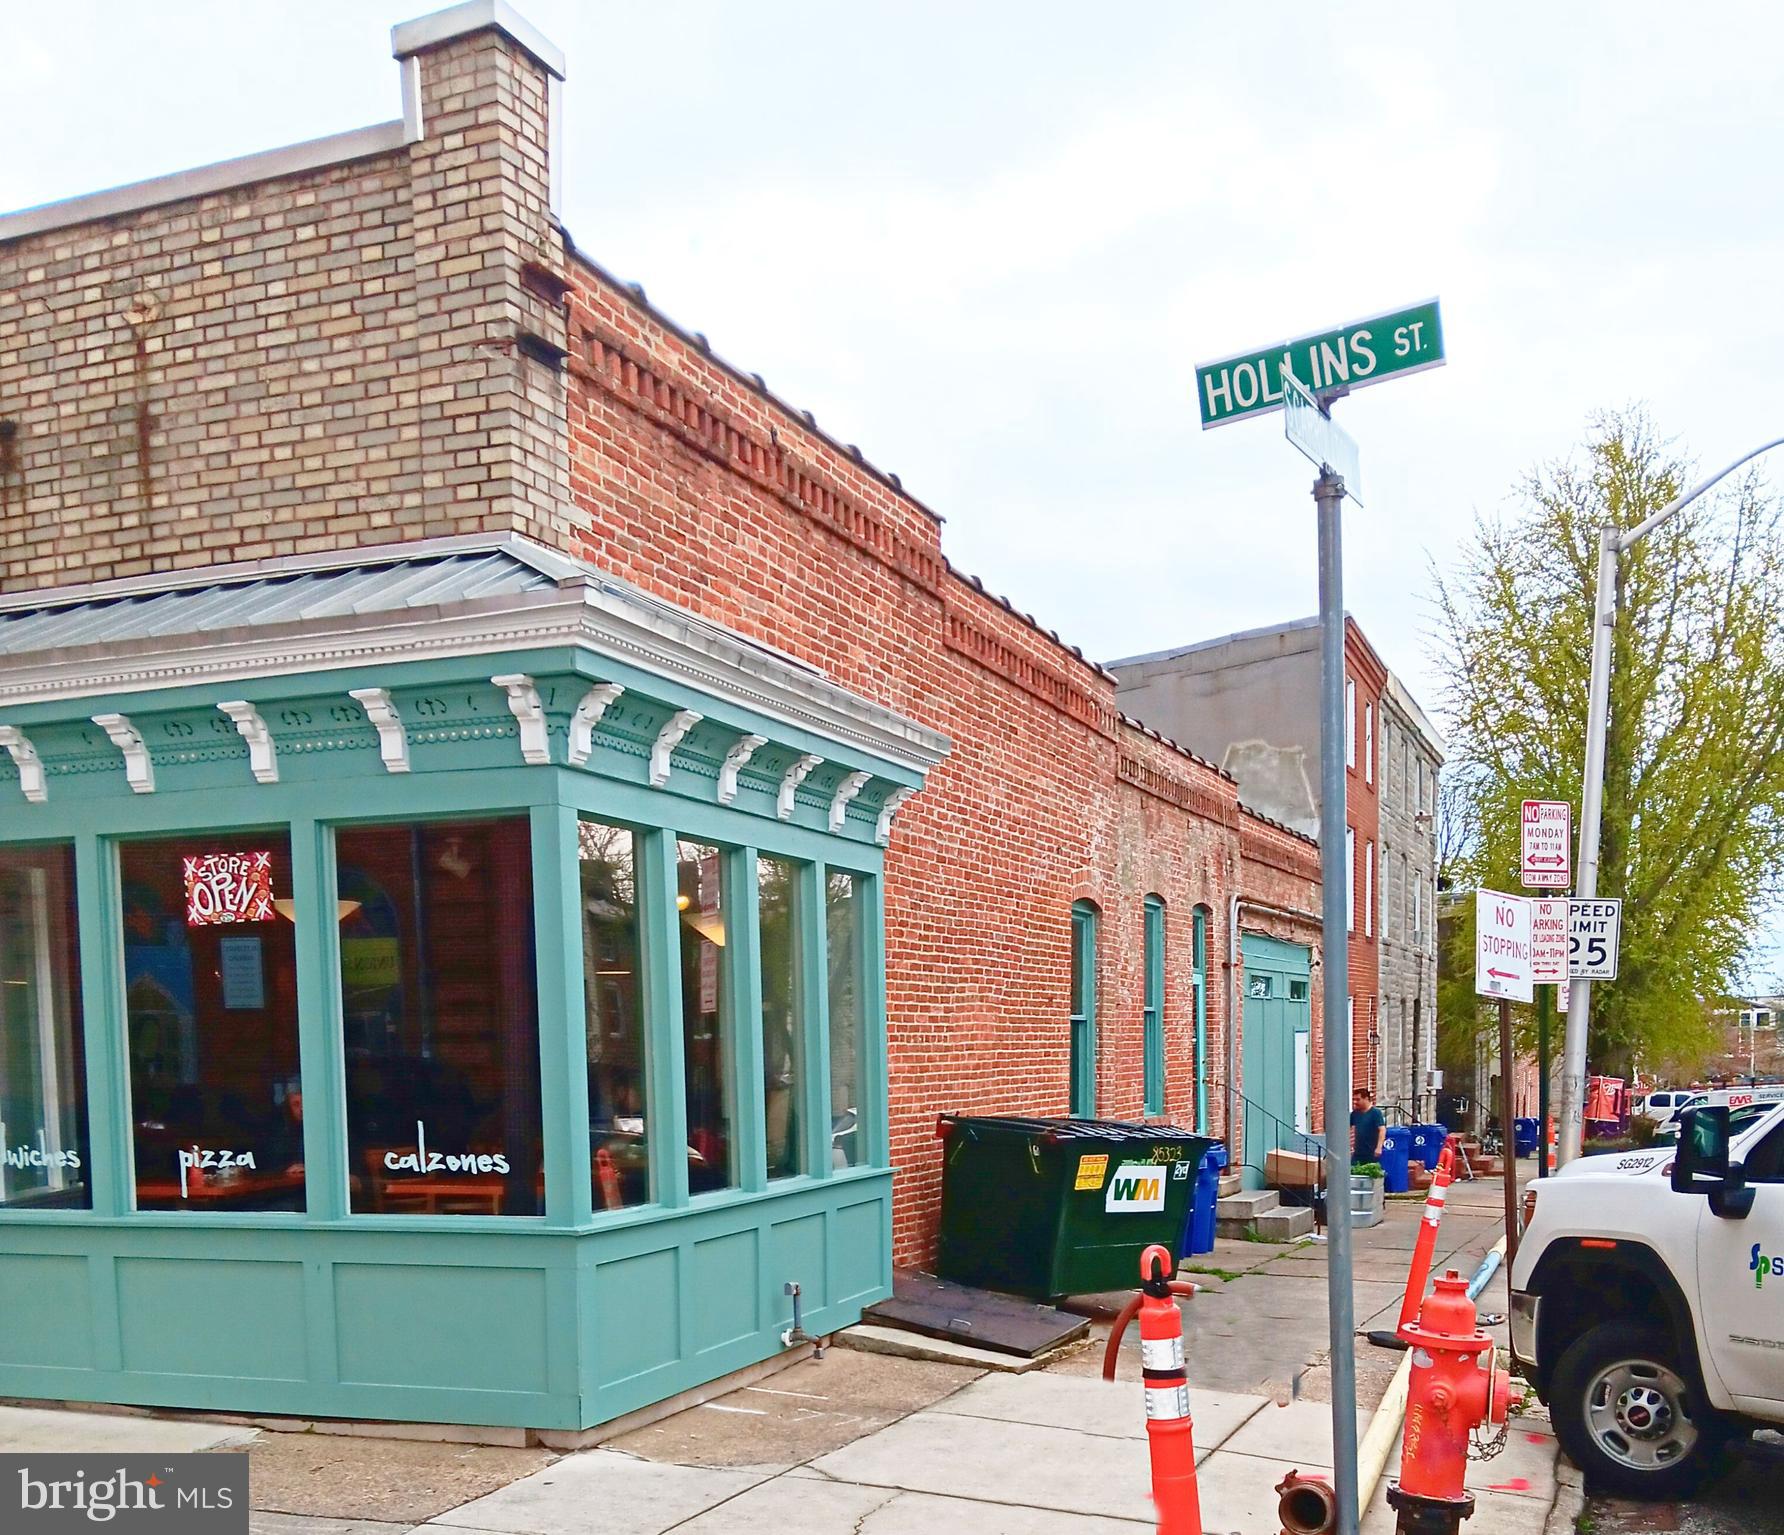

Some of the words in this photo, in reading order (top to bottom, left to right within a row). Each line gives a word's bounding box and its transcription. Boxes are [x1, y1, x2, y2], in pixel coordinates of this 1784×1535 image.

[1204, 329, 1377, 417] HOLLINS
[1393, 321, 1428, 357] ST.
[1524, 805, 1539, 821] NO
[1540, 808, 1566, 821] PARKING
[1527, 828, 1564, 838] MONDAY
[197, 856, 251, 881] STORE
[1525, 873, 1536, 882] TOW
[1538, 873, 1552, 882] AWAY
[1553, 873, 1567, 882] ZONE
[193, 872, 257, 916] OPEN
[1495, 905, 1514, 927] NO
[1539, 904, 1552, 915] NO
[1569, 905, 1616, 916] PEED
[1533, 919, 1564, 930] ARKING
[1569, 921, 1608, 933] IMIT
[1483, 934, 1528, 960] STOPPING
[1569, 937, 1607, 967] 25
[384, 1121, 510, 1174] calzones
[179, 1145, 256, 1198] pizza
[1616, 1157, 1654, 1170] SG2912
[1113, 1178, 1160, 1201] WM
